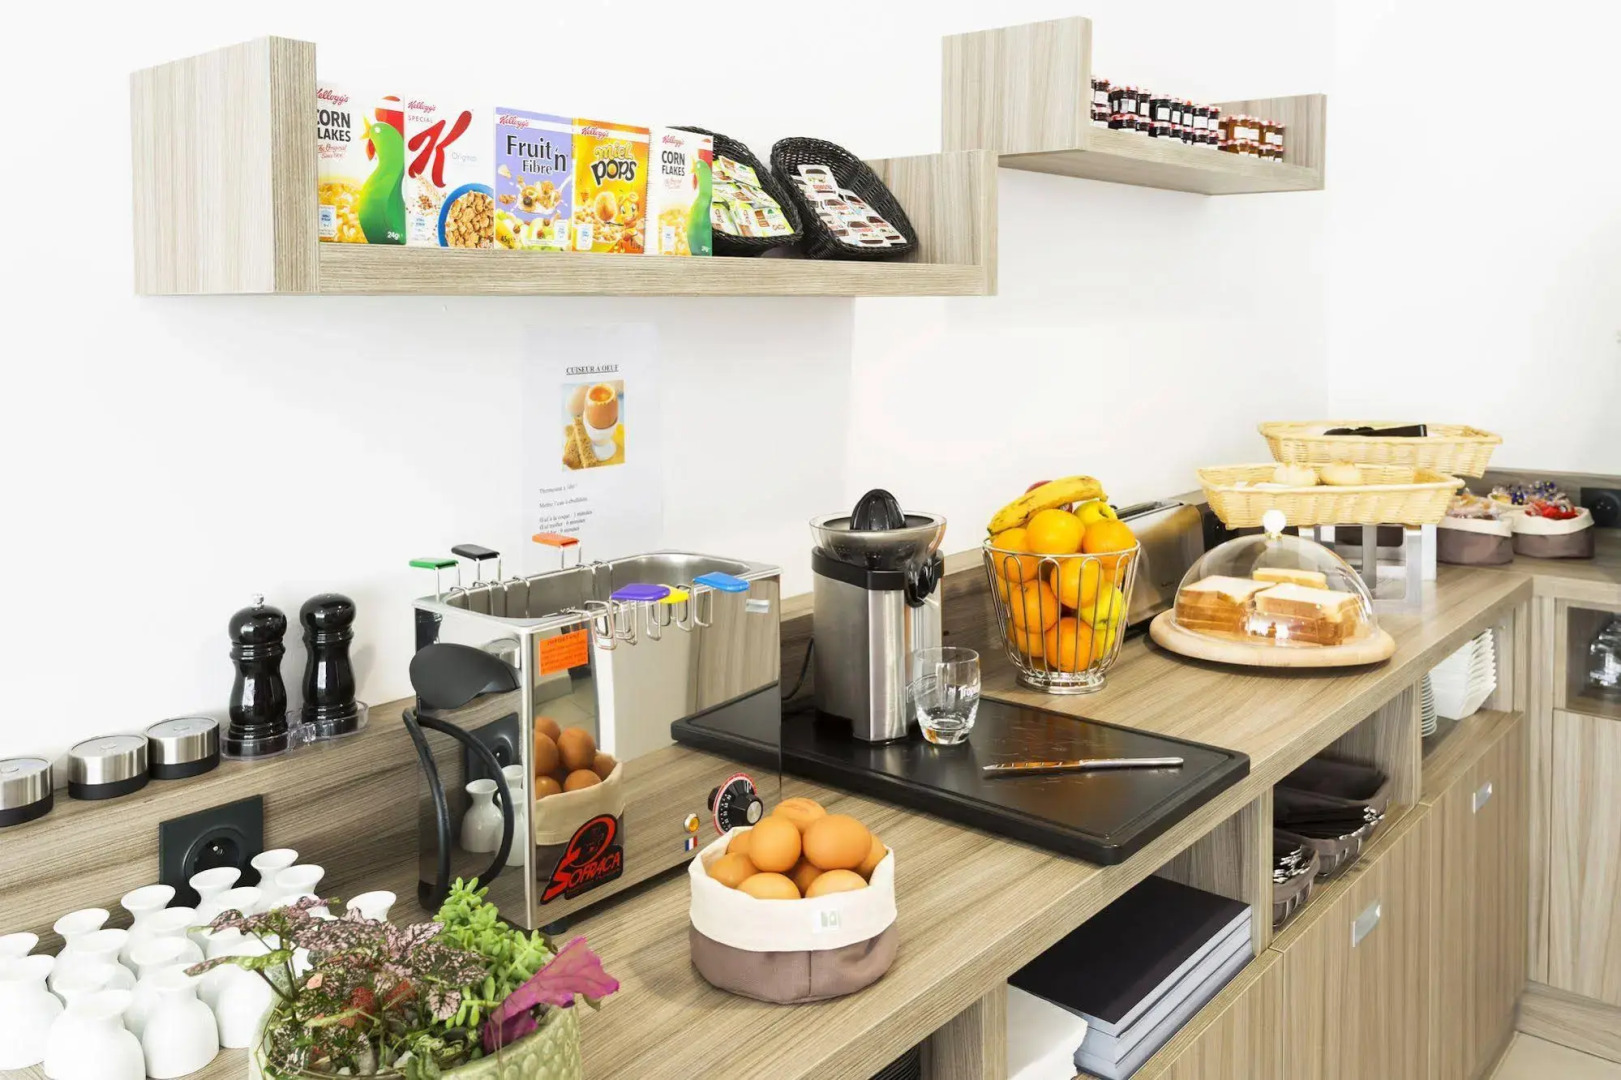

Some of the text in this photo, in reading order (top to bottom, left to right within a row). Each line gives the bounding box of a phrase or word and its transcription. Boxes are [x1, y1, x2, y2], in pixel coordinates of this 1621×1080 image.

[408, 100, 436, 113] Kellogg's
[317, 109, 350, 128] ORN
[408, 114, 434, 124] SPECIAL
[499, 114, 529, 130] Kellogg's
[317, 127, 351, 142] LAKES
[582, 126, 609, 139] Kellogg's
[408, 110, 472, 188] K
[506, 135, 551, 159] Fruit
[662, 150, 685, 166] CORN
[522, 159, 552, 175] Fibre
[662, 165, 685, 176] FLAKES
